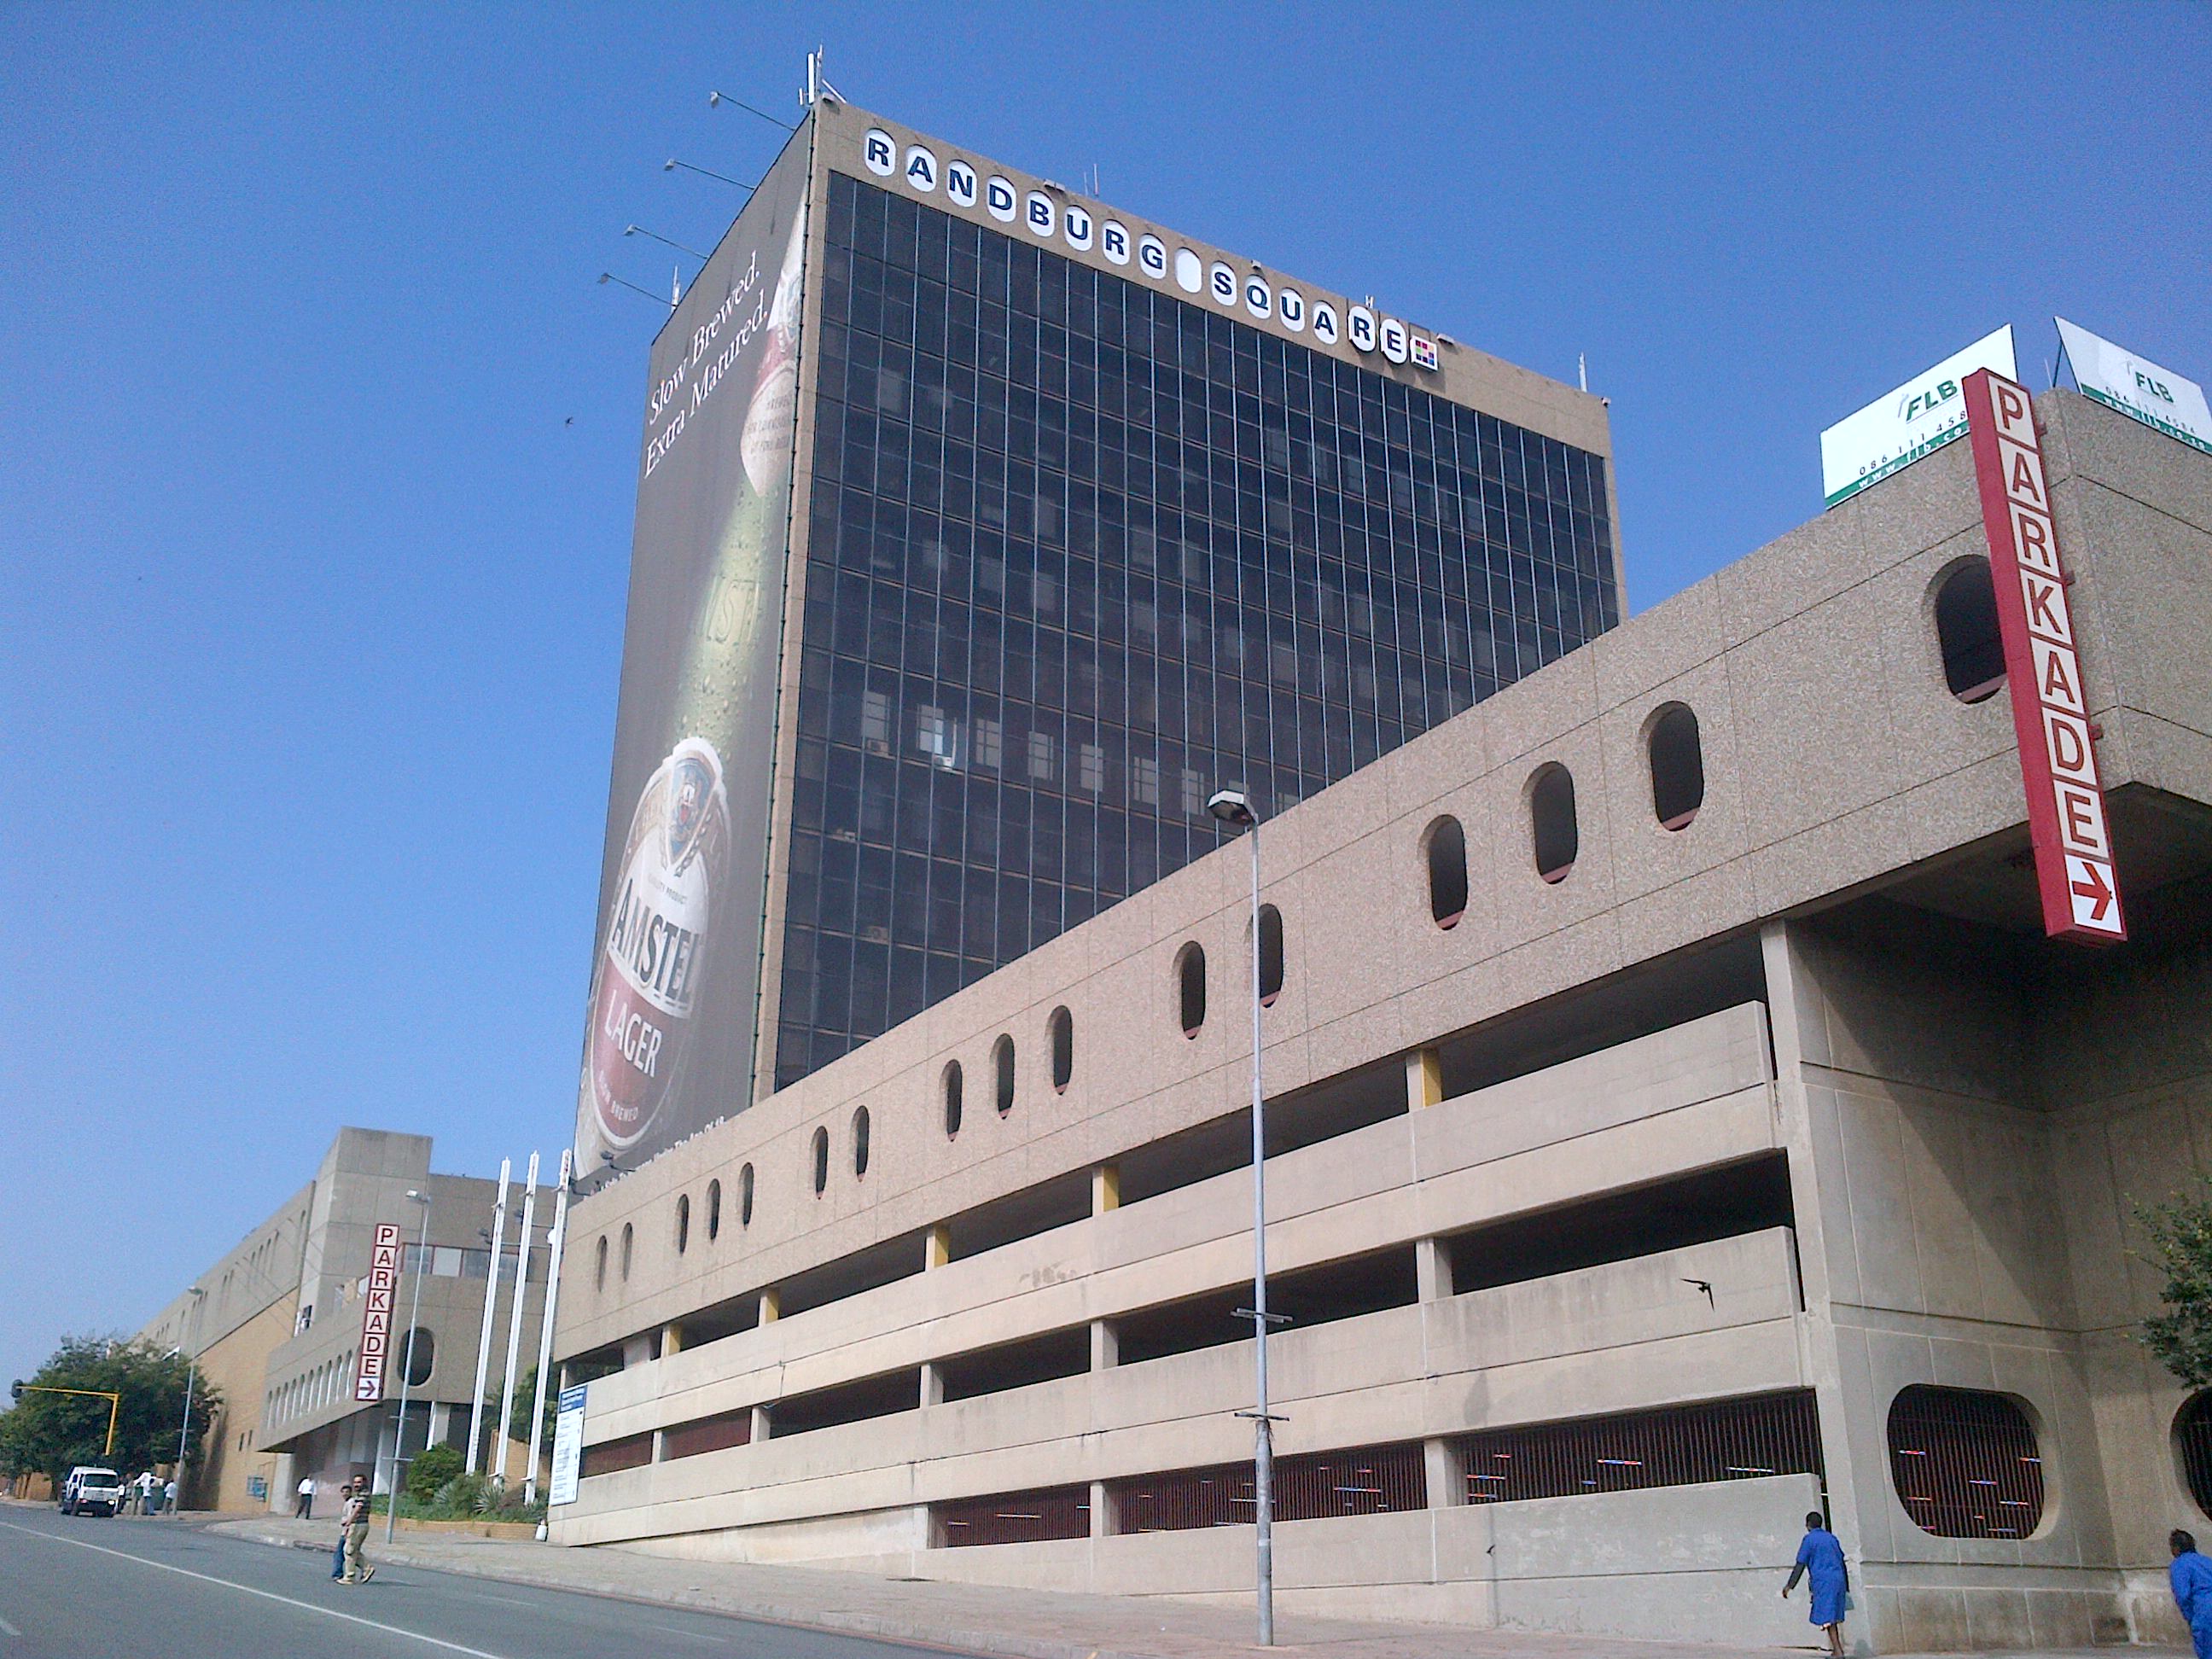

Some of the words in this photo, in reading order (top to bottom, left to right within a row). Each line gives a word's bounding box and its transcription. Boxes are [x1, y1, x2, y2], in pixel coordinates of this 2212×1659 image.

[867, 137, 1163, 271] RANDBURG
[1214, 271, 1402, 352] SQUARE
[644, 409, 685, 480] Extra
[690, 288, 769, 418] Matured.
[649, 357, 688, 426] Slow
[691, 250, 760, 369] Brewed.
[2134, 371, 2174, 404] FLB
[1858, 427, 1967, 488] www.flb.co
[1906, 380, 1958, 422] FLB
[1936, 410, 1967, 432] 458
[1997, 385, 2098, 849] PARKADE
[612, 878, 701, 1003] AMSTEL
[604, 989, 662, 1078] LAGER
[364, 1227, 393, 1375] PARKADE
